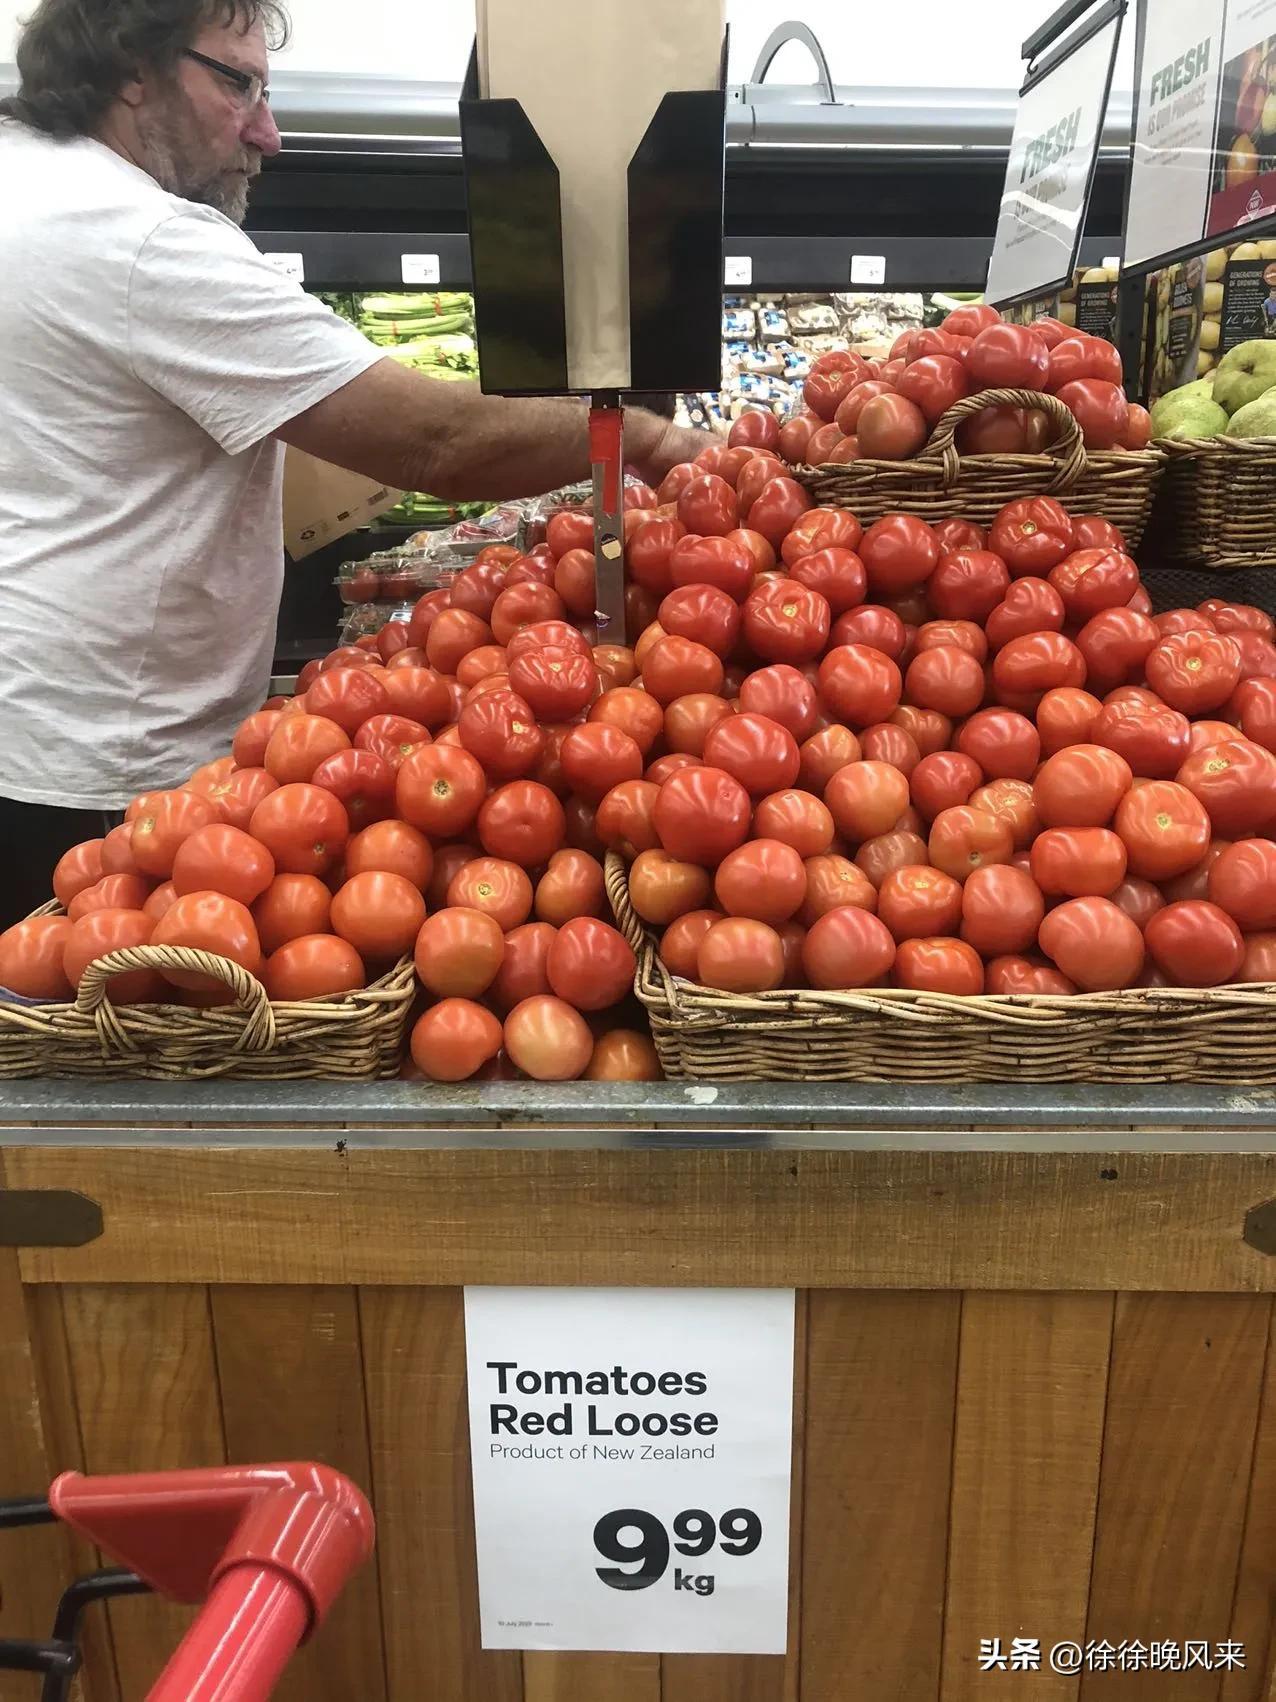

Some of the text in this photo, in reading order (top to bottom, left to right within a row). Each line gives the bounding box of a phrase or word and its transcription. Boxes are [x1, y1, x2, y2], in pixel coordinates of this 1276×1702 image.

[1150, 37, 1211, 107] FRESH
[1020, 106, 1082, 184] FRESH
[486, 1361, 708, 1396] Tomatoes
[489, 1402, 719, 1437] Red Loose
[489, 1443, 716, 1461] Product of New Zealand
[674, 1567, 716, 1597] kg
